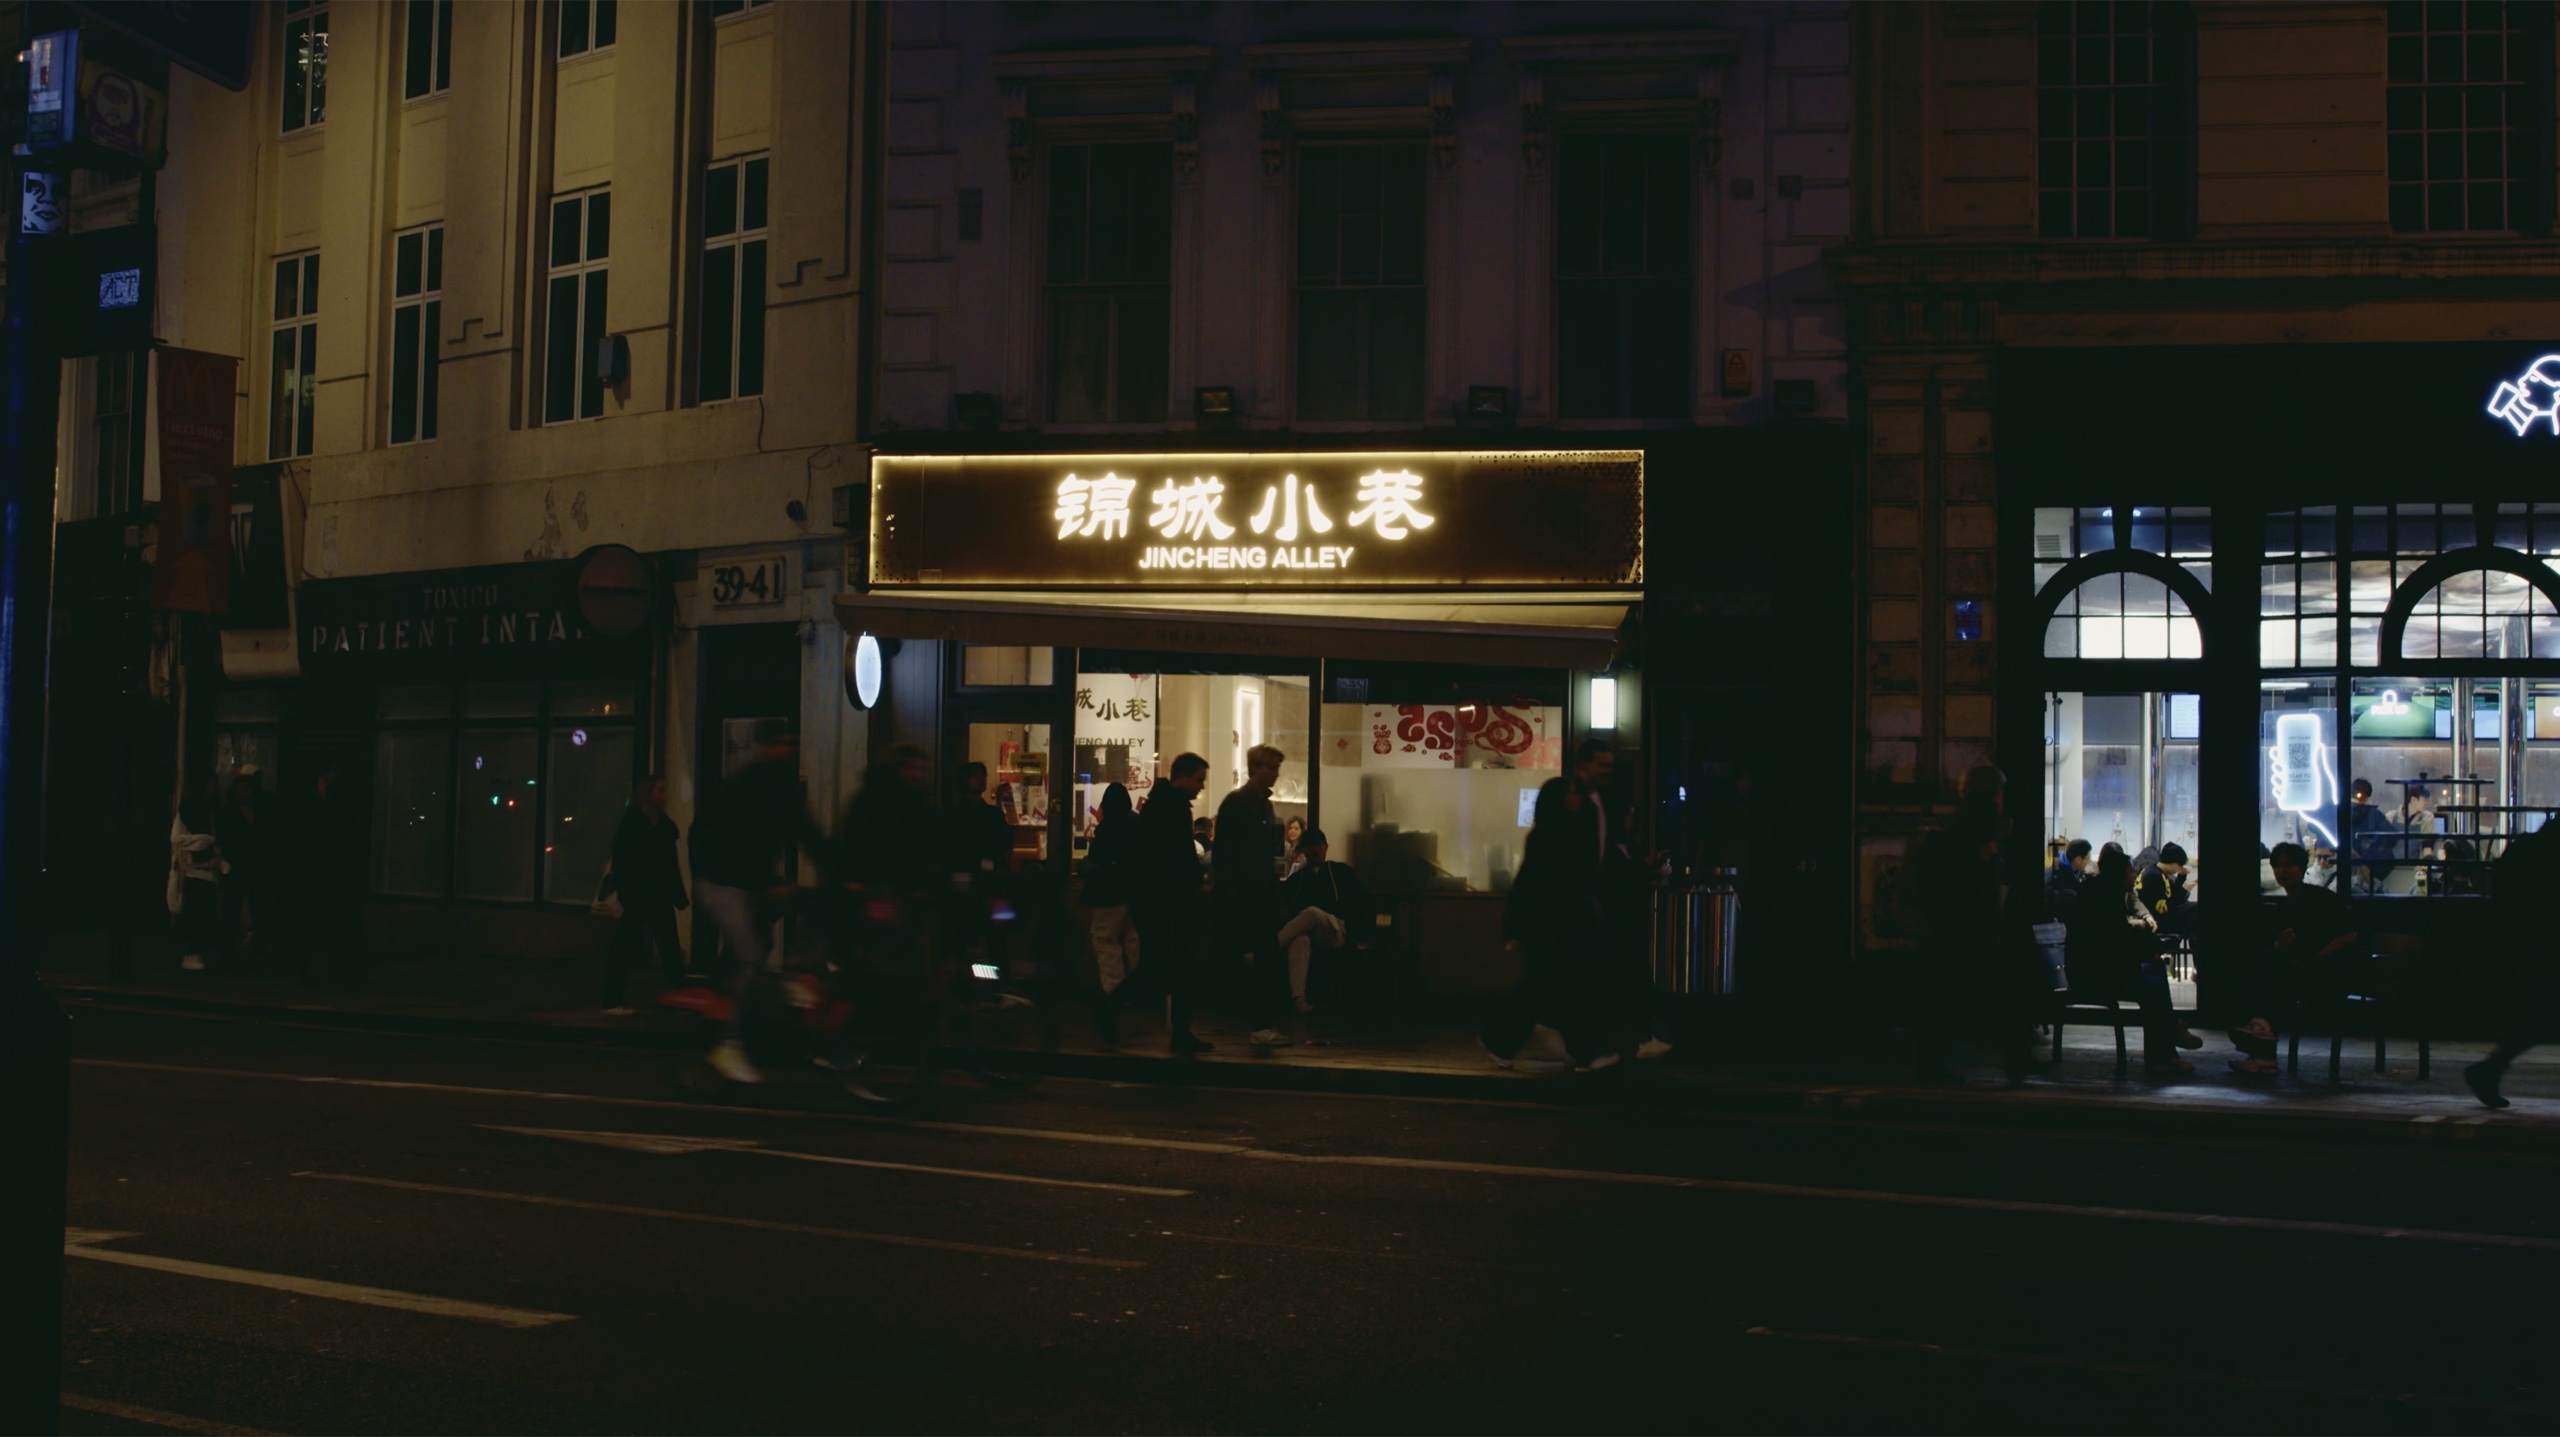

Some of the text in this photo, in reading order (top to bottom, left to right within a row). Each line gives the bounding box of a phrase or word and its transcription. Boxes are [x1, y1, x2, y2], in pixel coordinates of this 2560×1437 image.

[1055, 469, 1434, 541] 锦城小巷
[1138, 547, 1354, 569] JINCHENG ALLEY
[713, 563, 780, 602] 39-41
[312, 610, 583, 653] PATIENT INTA
